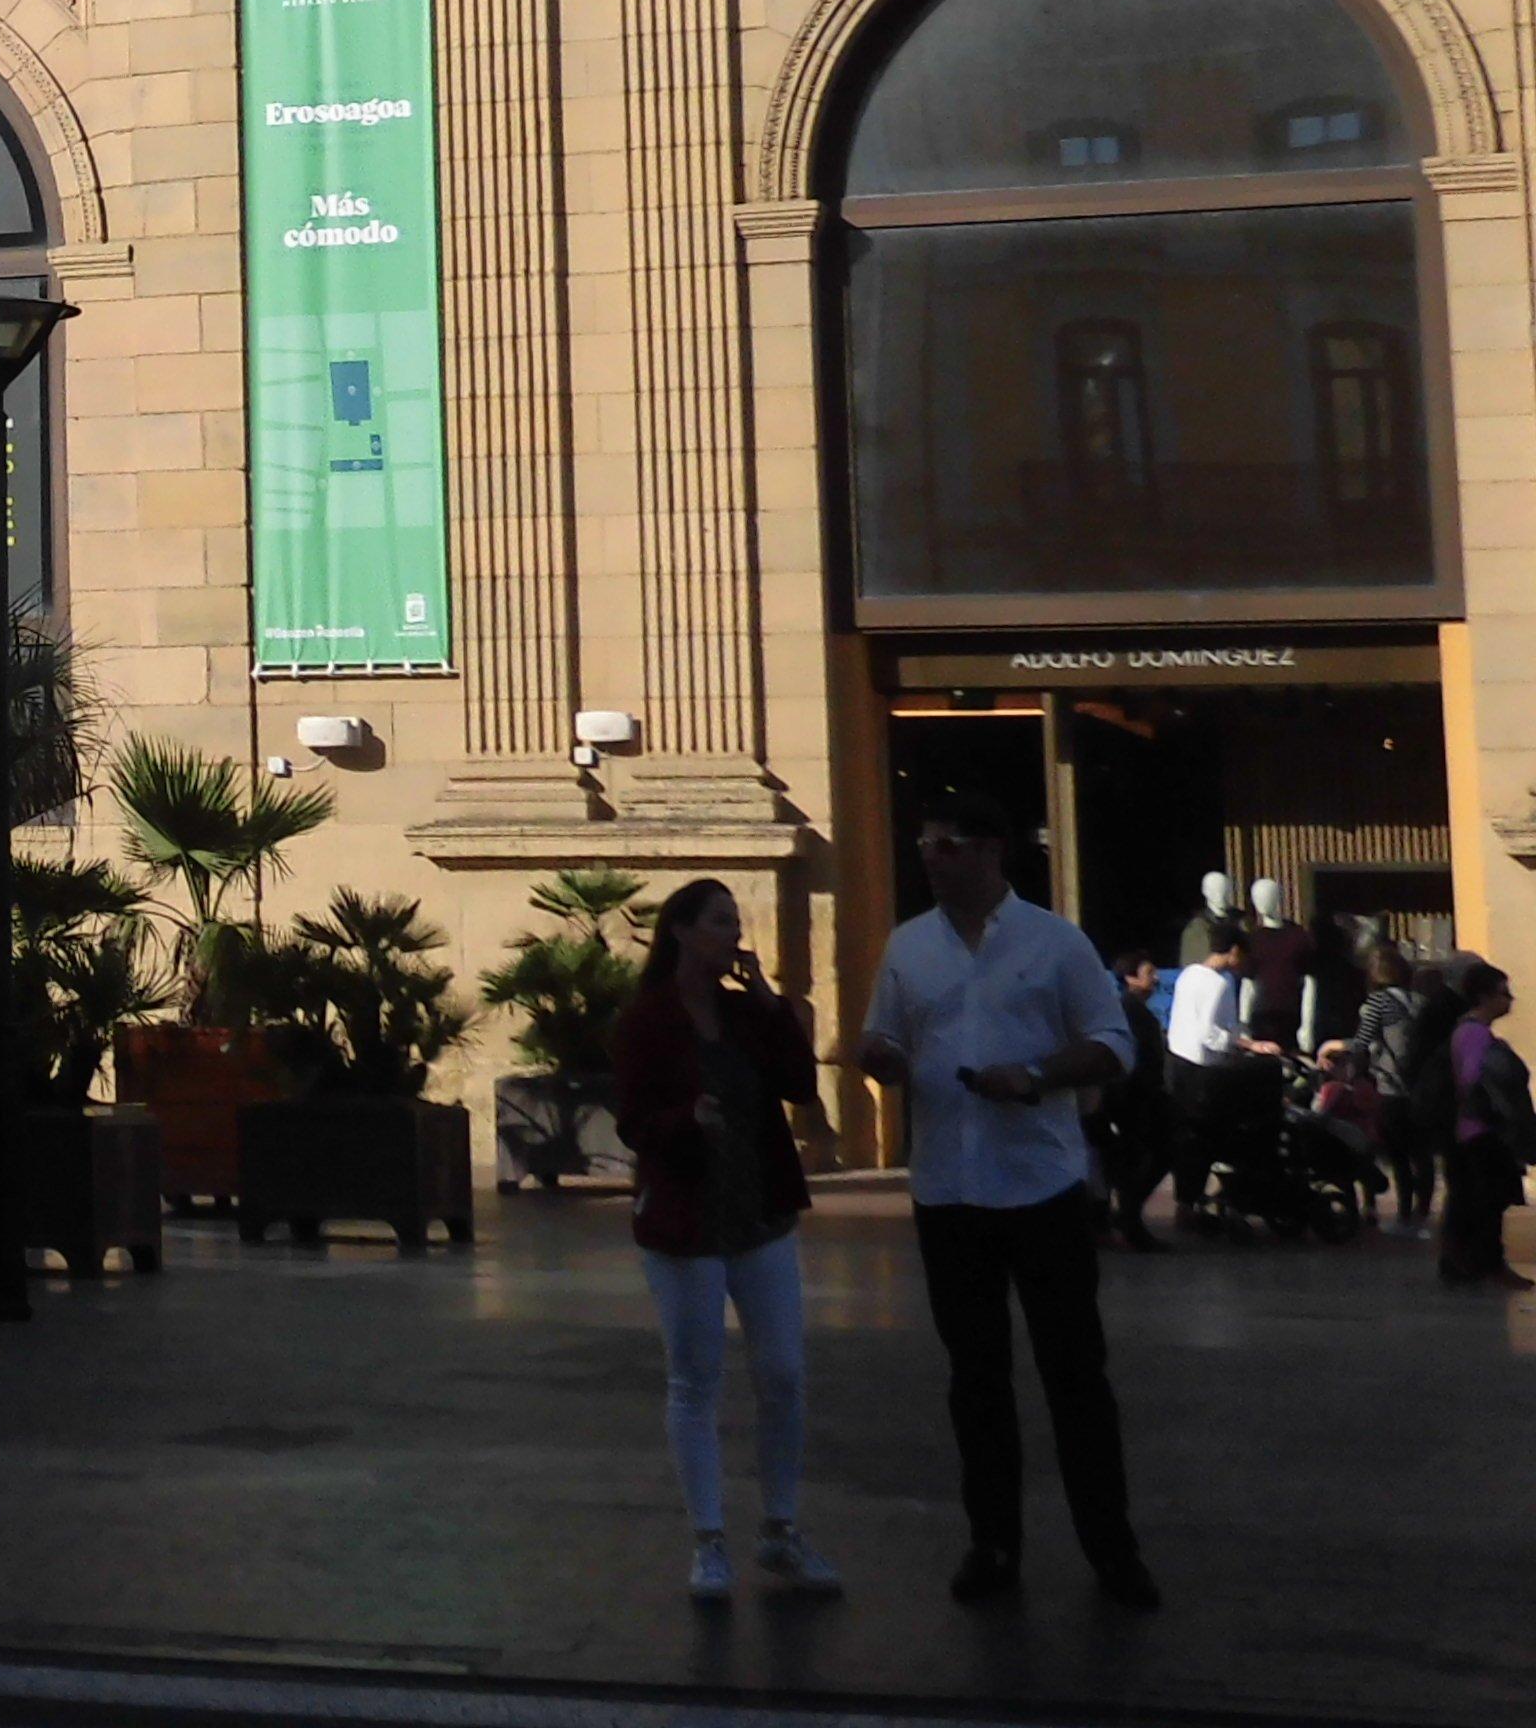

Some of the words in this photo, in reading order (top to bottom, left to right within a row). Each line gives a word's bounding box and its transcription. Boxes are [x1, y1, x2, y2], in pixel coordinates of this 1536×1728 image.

[266, 98, 412, 126] Erosoagoa
[310, 191, 370, 218] Más
[284, 220, 398, 247] cómodo
